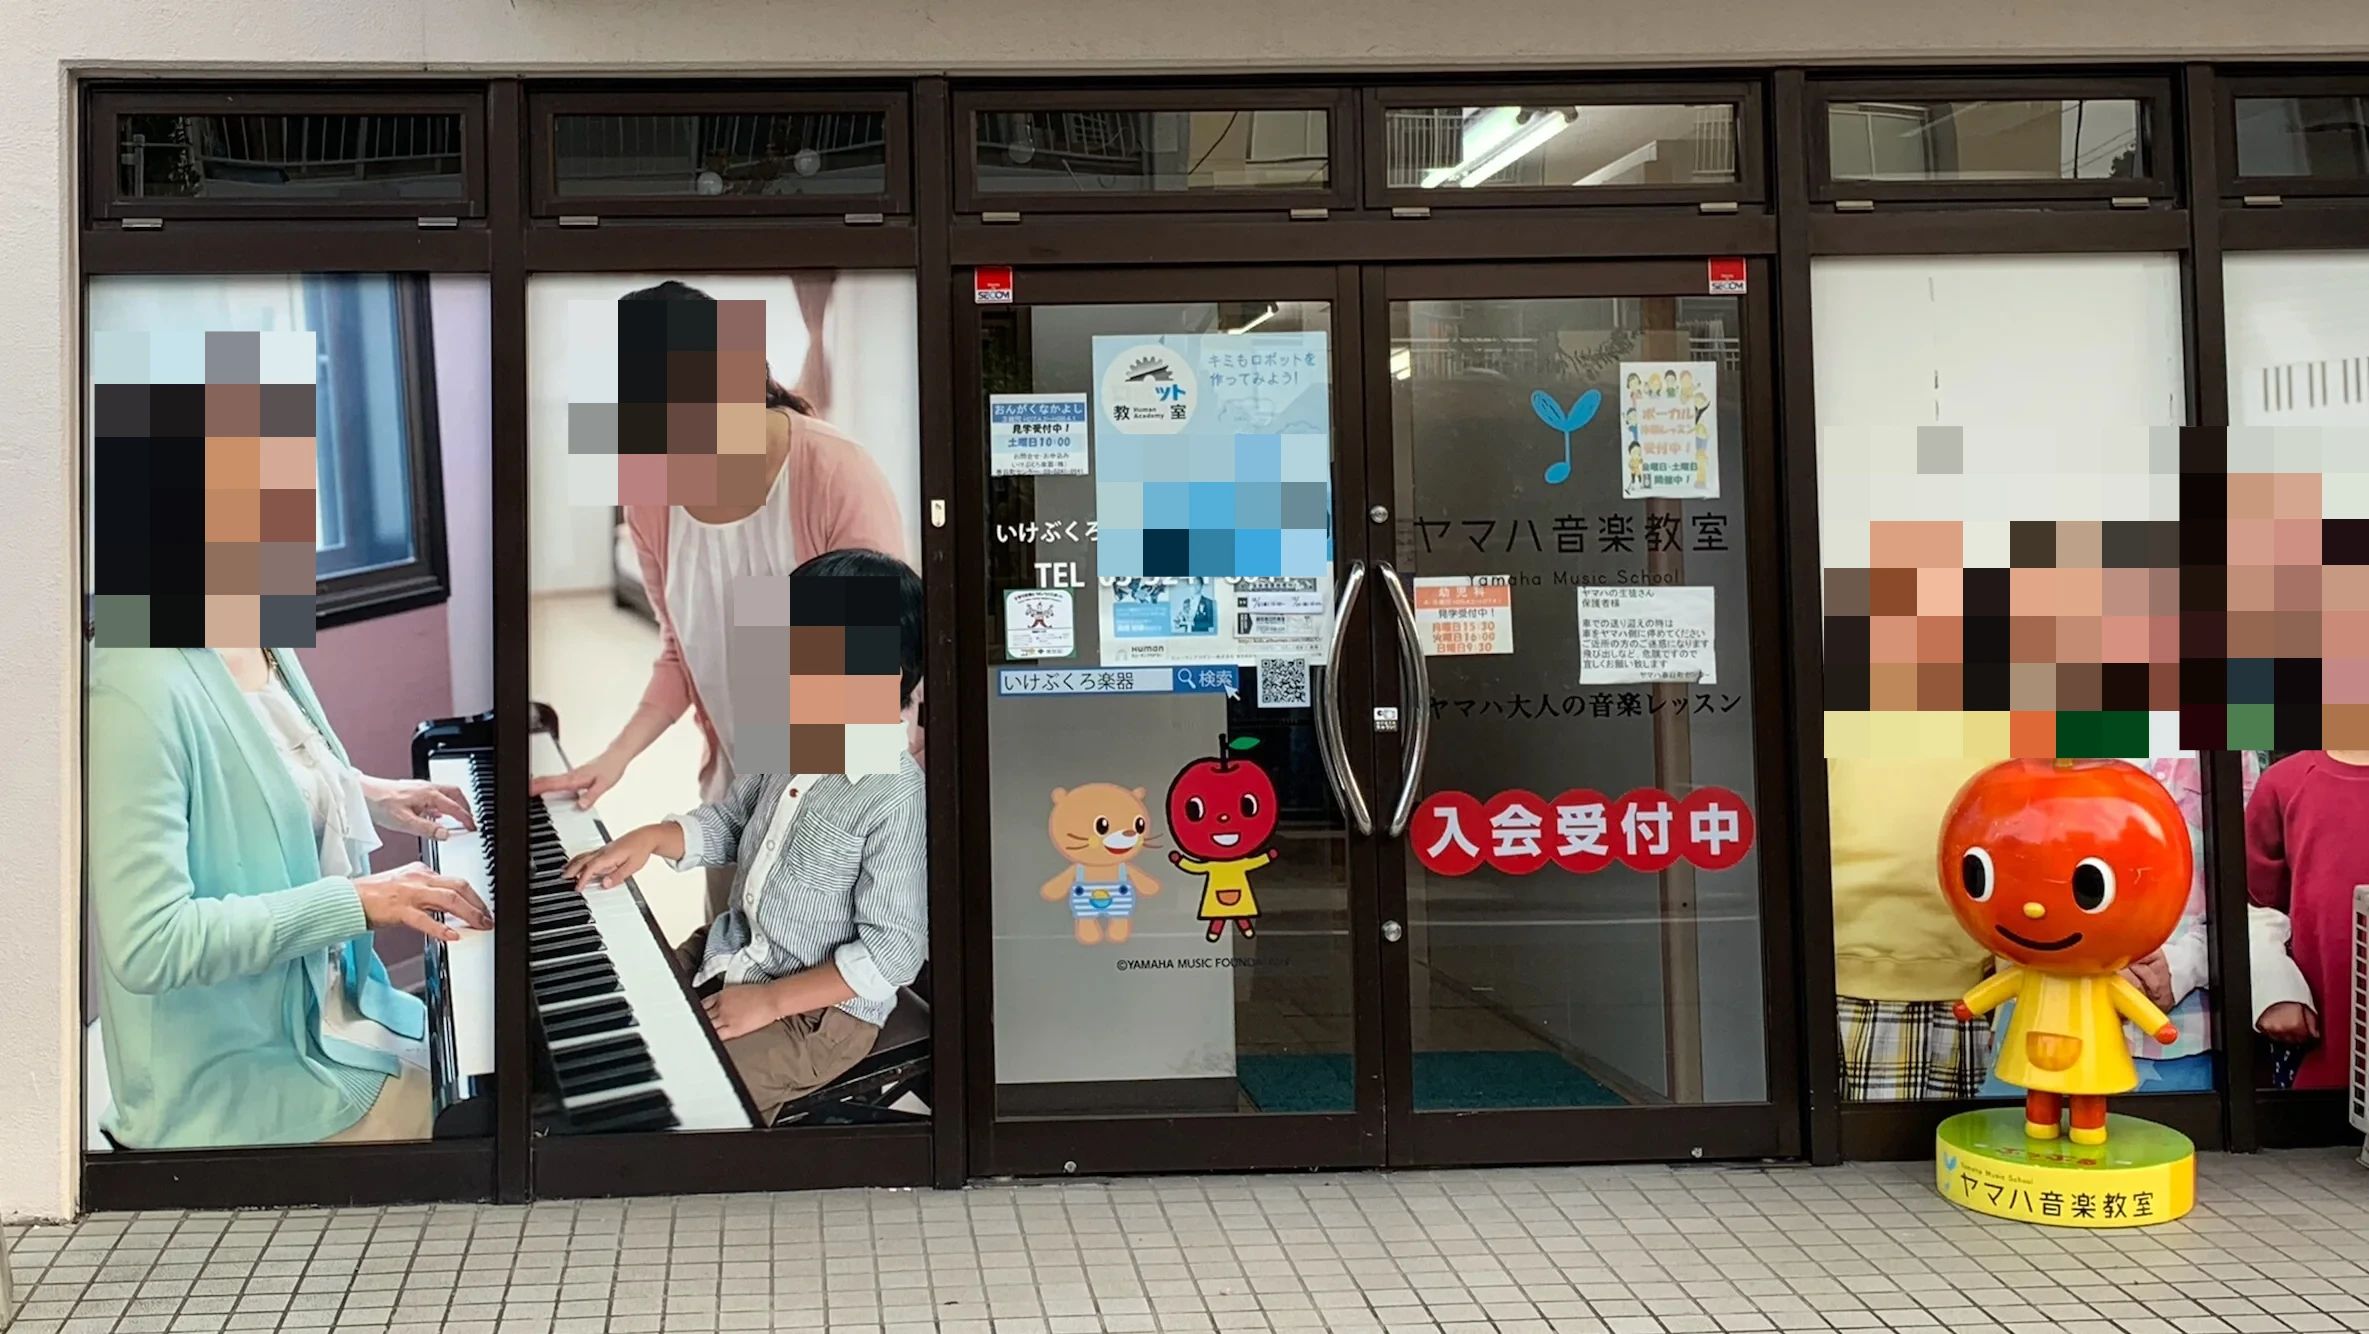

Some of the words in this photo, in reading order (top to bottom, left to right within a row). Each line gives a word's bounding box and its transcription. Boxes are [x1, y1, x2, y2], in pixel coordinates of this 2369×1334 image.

[1711, 282, 1744, 290] SECOM
[977, 291, 1010, 300] SECOM
[1208, 352, 1316, 368] キミもロボットを
[994, 403, 1083, 415] おんがくなかよし
[1642, 407, 1694, 420] ボーカル
[1413, 511, 1729, 553] ヤマハ音楽教室
[1034, 561, 1086, 589] TEL
[1467, 573, 1542, 587] Yamaha
[1553, 571, 1608, 586] Music
[1617, 569, 1681, 586] School
[1582, 589, 1655, 598] ヤマハの生徒さん
[1003, 671, 1134, 692] いけぶくろ楽器
[1198, 669, 1234, 689] 検索
[1428, 692, 1742, 720] ヤマハ大人の音楽レッスン
[1426, 801, 1740, 859] 入会受付中
[1177, 957, 1213, 969] MUSIC
[1960, 1172, 2154, 1219] ヤマハ音楽教室
